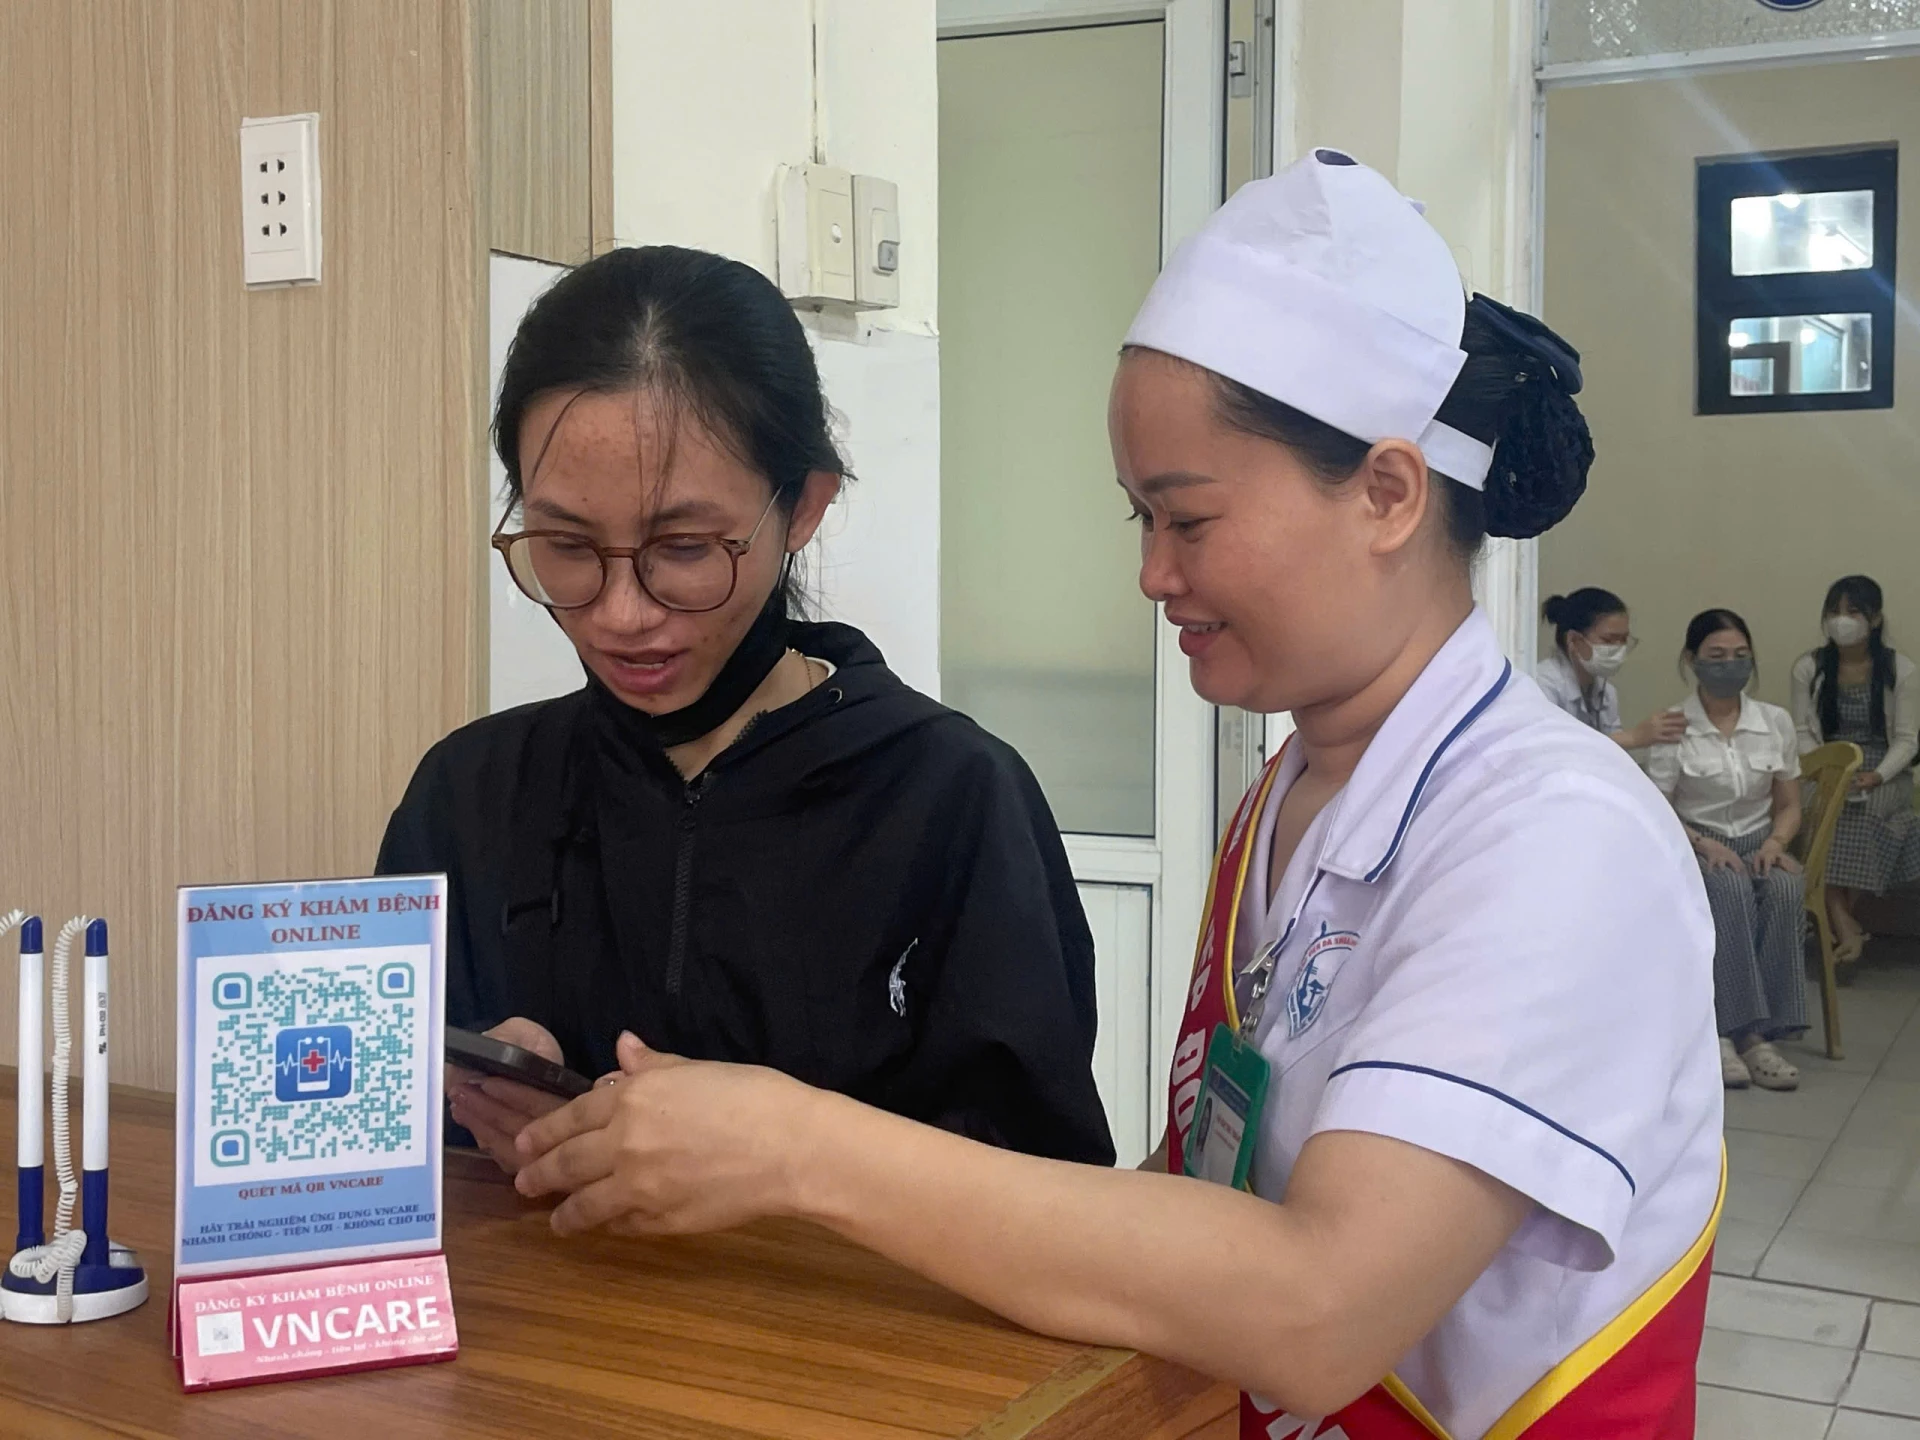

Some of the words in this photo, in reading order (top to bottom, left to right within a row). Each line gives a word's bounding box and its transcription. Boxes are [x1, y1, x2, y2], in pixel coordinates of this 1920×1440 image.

[187, 902, 254, 923] ĐĂNG
[262, 899, 293, 919] KÝ
[301, 896, 369, 917] KHÁM
[377, 893, 440, 915] BỆNH
[271, 924, 361, 944] ONLINE
[238, 1186, 277, 1200] QUÉT
[281, 1182, 302, 1195] MÃ
[306, 1181, 326, 1193] QR
[329, 1176, 384, 1190] VNCARE
[374, 1203, 420, 1217] VNCARE
[182, 1234, 226, 1247] NHANH
[272, 1287, 321, 1305] KHÁM
[325, 1281, 371, 1299] BỆNH
[374, 1273, 435, 1292] ONLINE
[252, 1295, 441, 1349] VNCARE
